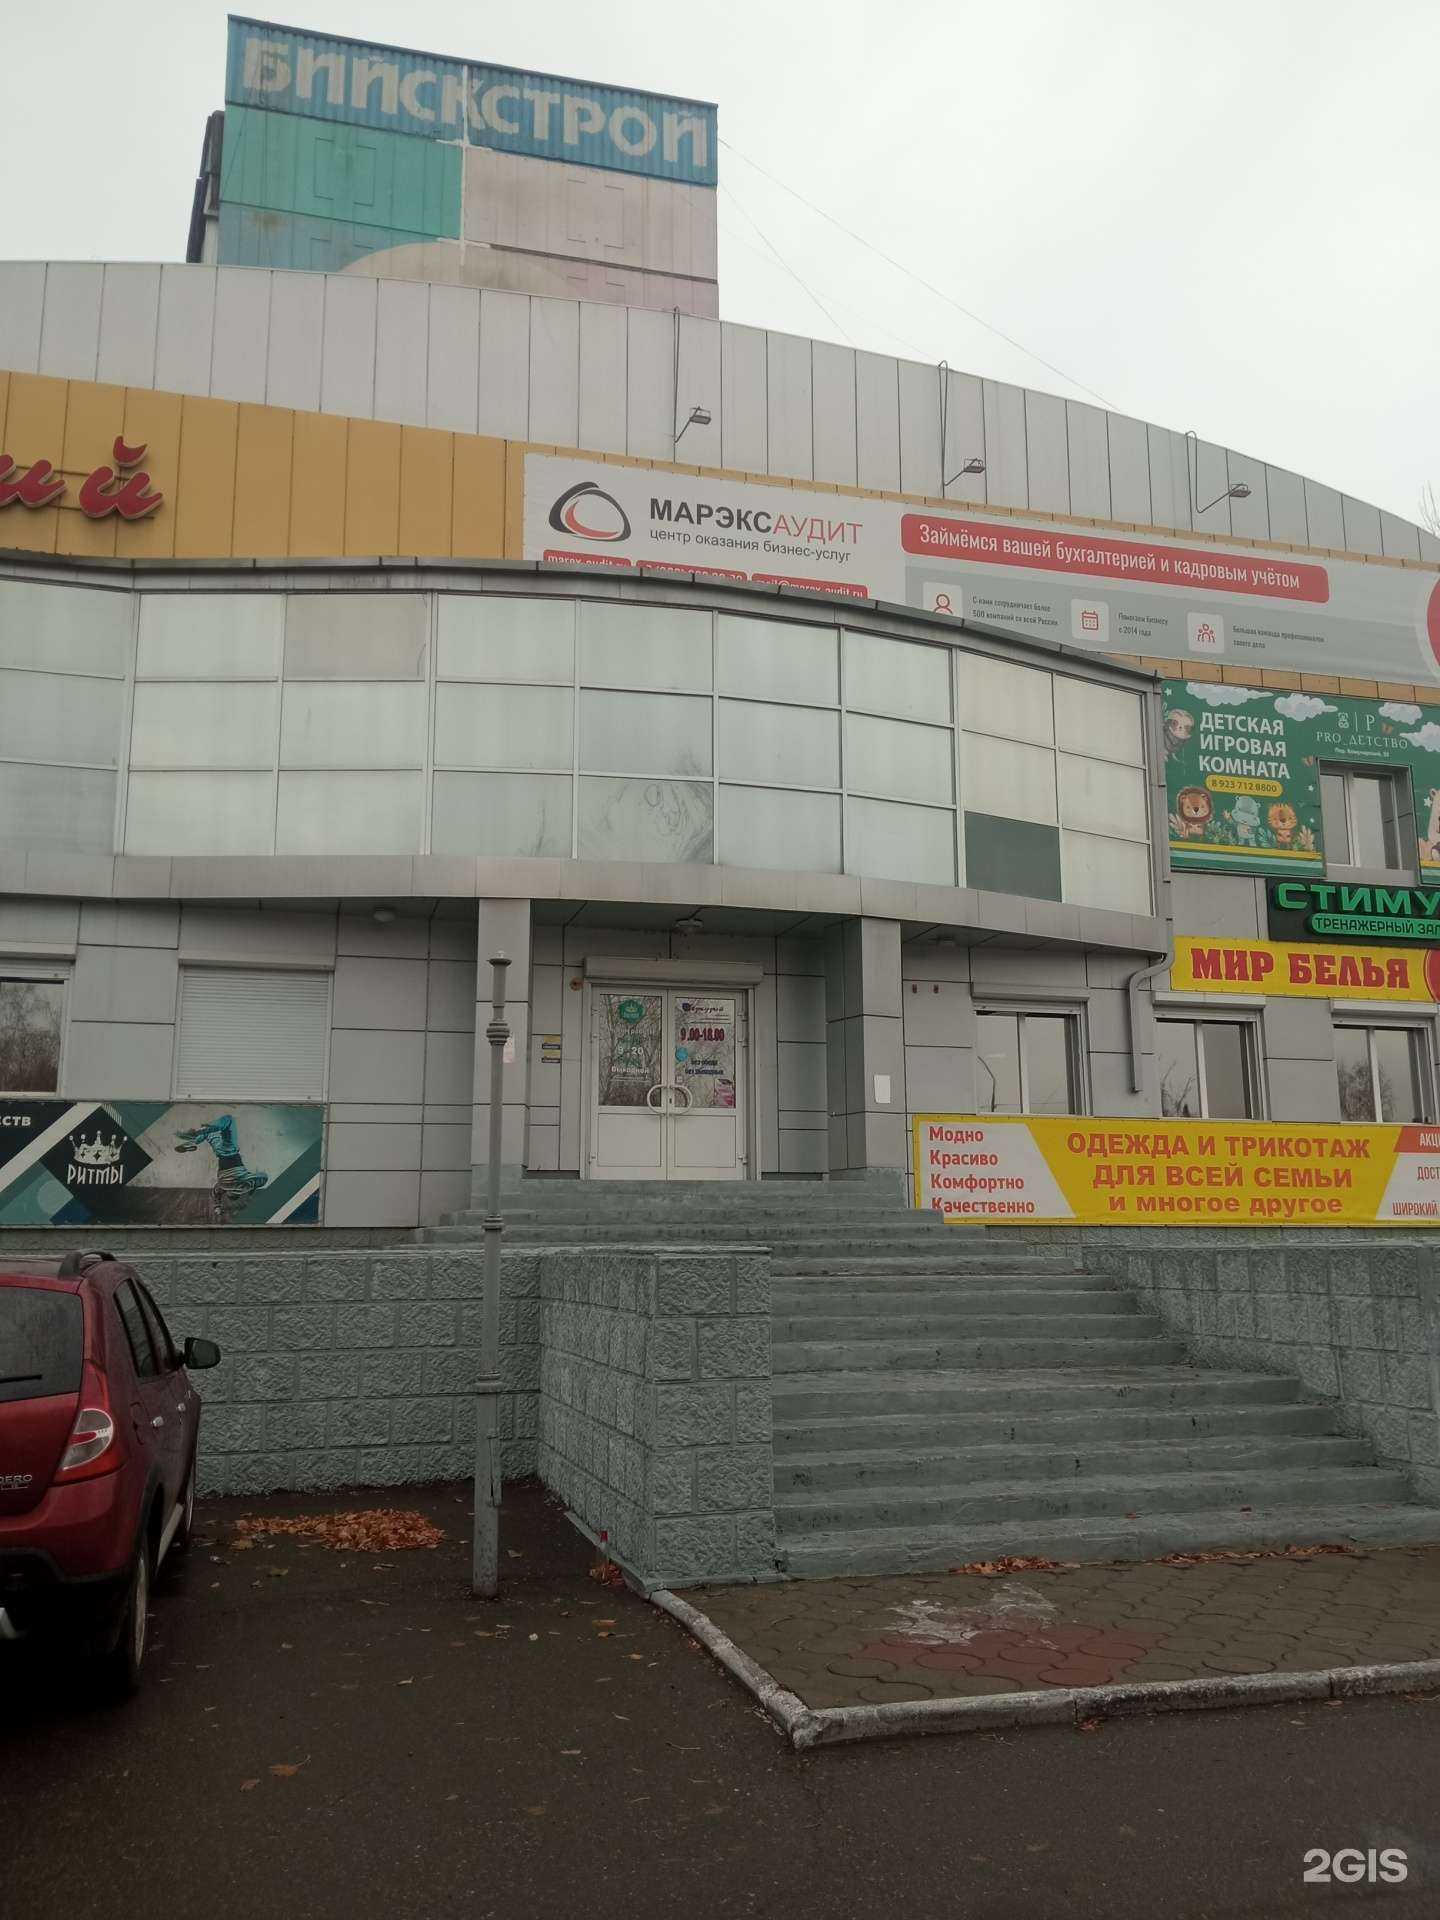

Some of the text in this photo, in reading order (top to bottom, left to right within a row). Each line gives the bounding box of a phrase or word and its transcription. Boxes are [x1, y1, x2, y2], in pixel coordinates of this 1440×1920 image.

[650, 498, 863, 544] МАРЭКСАУДИТ
[650, 529, 851, 562] центр оказания бизнес-услуг
[920, 524, 1300, 588] Займёмся вашей бухгалтерией и кадровым учётом
[1200, 712, 1284, 736] ДЕТСКАЯ
[1200, 733, 1287, 757] ИГРОВАЯ
[1199, 755, 1291, 779] КОМНАТА
[1315, 917, 1414, 934] ТРЕНАЖЕРНЫЙ
[1191, 948, 1410, 989] МИР БЕЛЬЯ
[929, 1126, 984, 1144] Модно
[1068, 1133, 1371, 1158] ОДЕЖДА И ТРИКОТАЖ
[930, 1150, 998, 1168] Красиво
[931, 1173, 1024, 1193] Комфортно
[1093, 1162, 1353, 1189] ДЛЯ ВСЕЙ СЕМЬИ
[931, 1197, 1035, 1213] Качественно
[1108, 1196, 1343, 1218] и многое другое
[1392, 1200, 1438, 1216] ШИРОКИЙ
